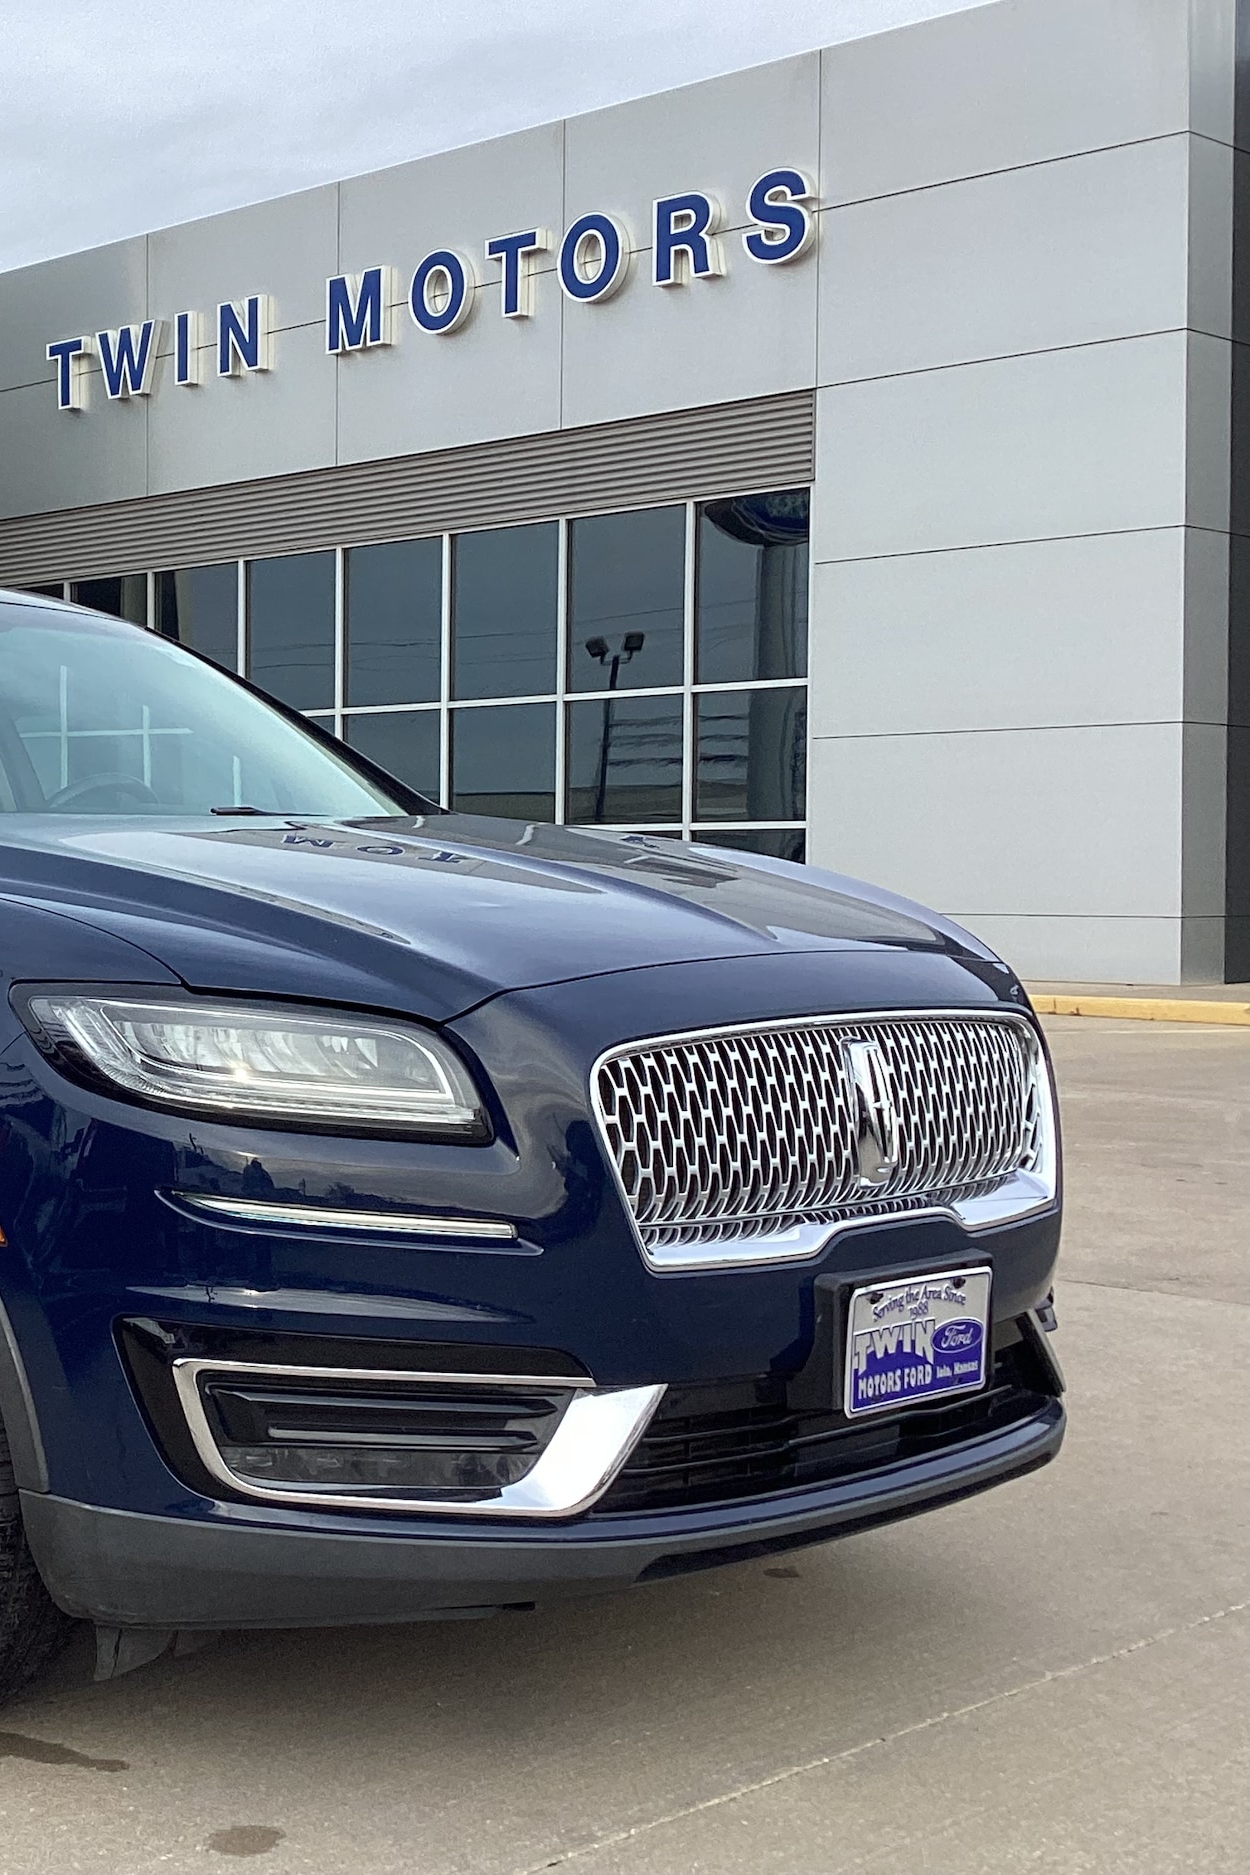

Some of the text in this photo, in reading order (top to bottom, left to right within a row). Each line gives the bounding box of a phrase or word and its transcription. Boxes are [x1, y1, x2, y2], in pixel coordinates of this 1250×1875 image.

[46, 166, 812, 410] TWIN MOTORS
[872, 1284, 966, 1322] Serving the Area Since
[853, 1317, 935, 1375] TWIN
[940, 1323, 973, 1348] Ford
[858, 1363, 933, 1400] MOTORS FORD
